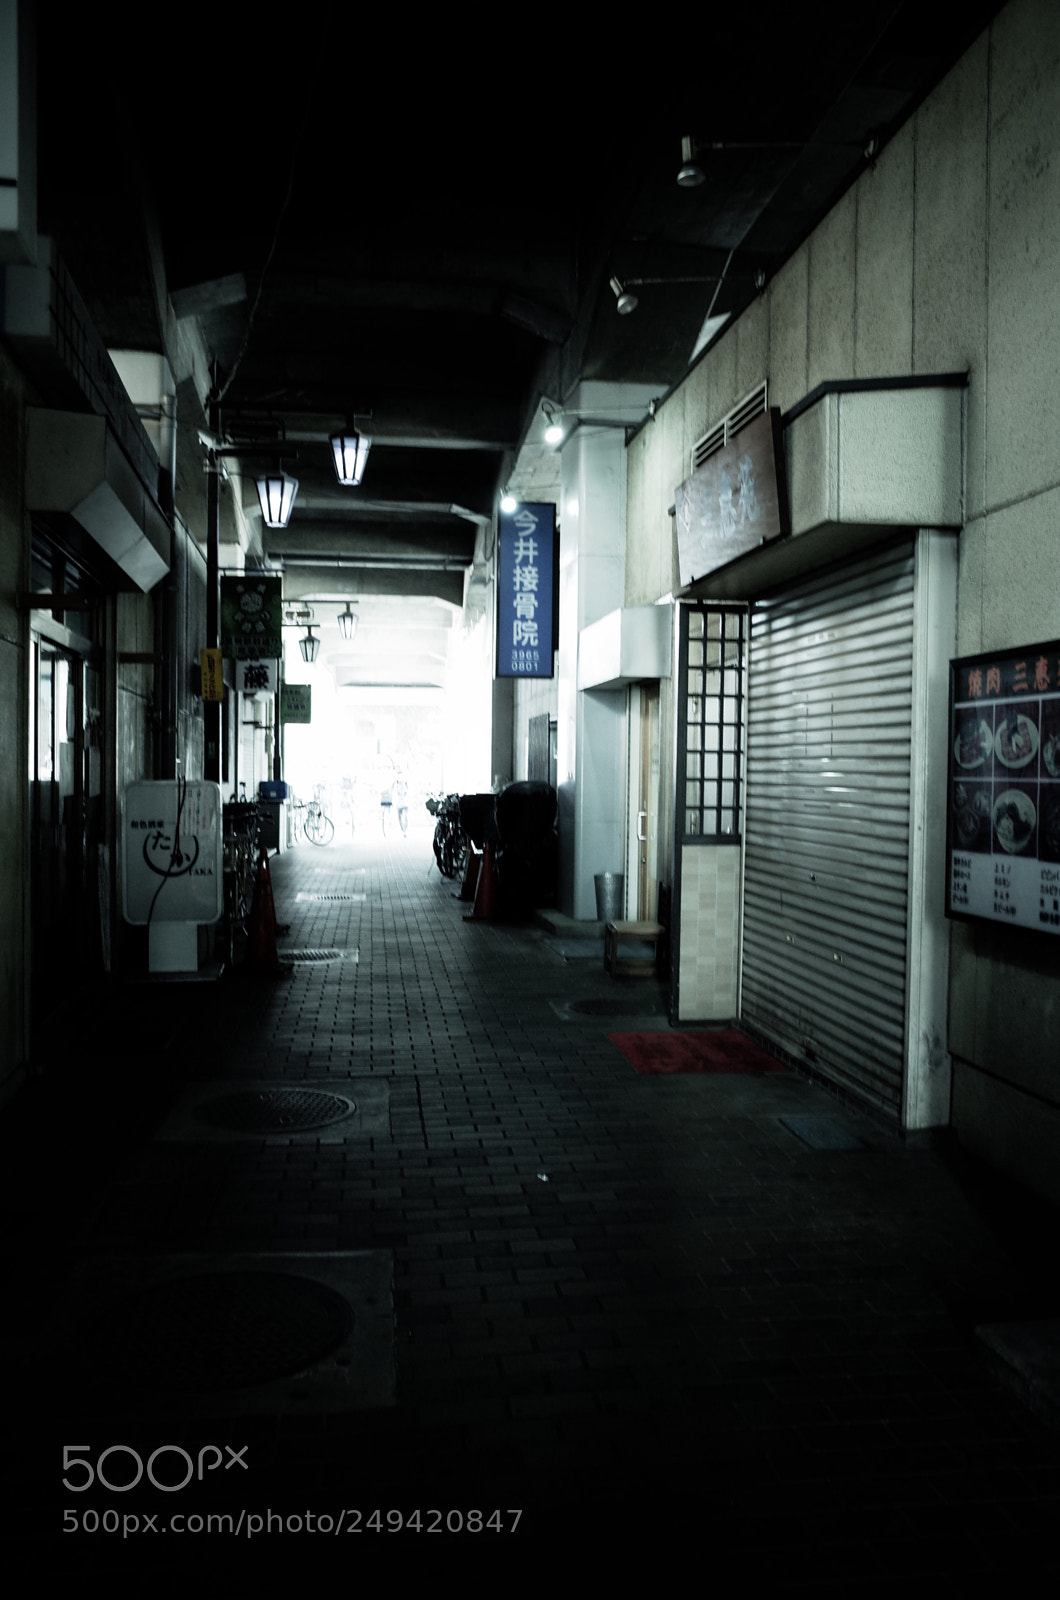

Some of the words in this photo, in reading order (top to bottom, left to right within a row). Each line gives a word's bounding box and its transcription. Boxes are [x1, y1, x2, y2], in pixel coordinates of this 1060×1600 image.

[513, 509, 539, 648] 今井接骨院
[511, 661, 539, 672] 0801
[968, 665, 1001, 698] 焼肉
[1012, 655, 1060, 693] 三恵
[188, 867, 213, 876] TAKA
